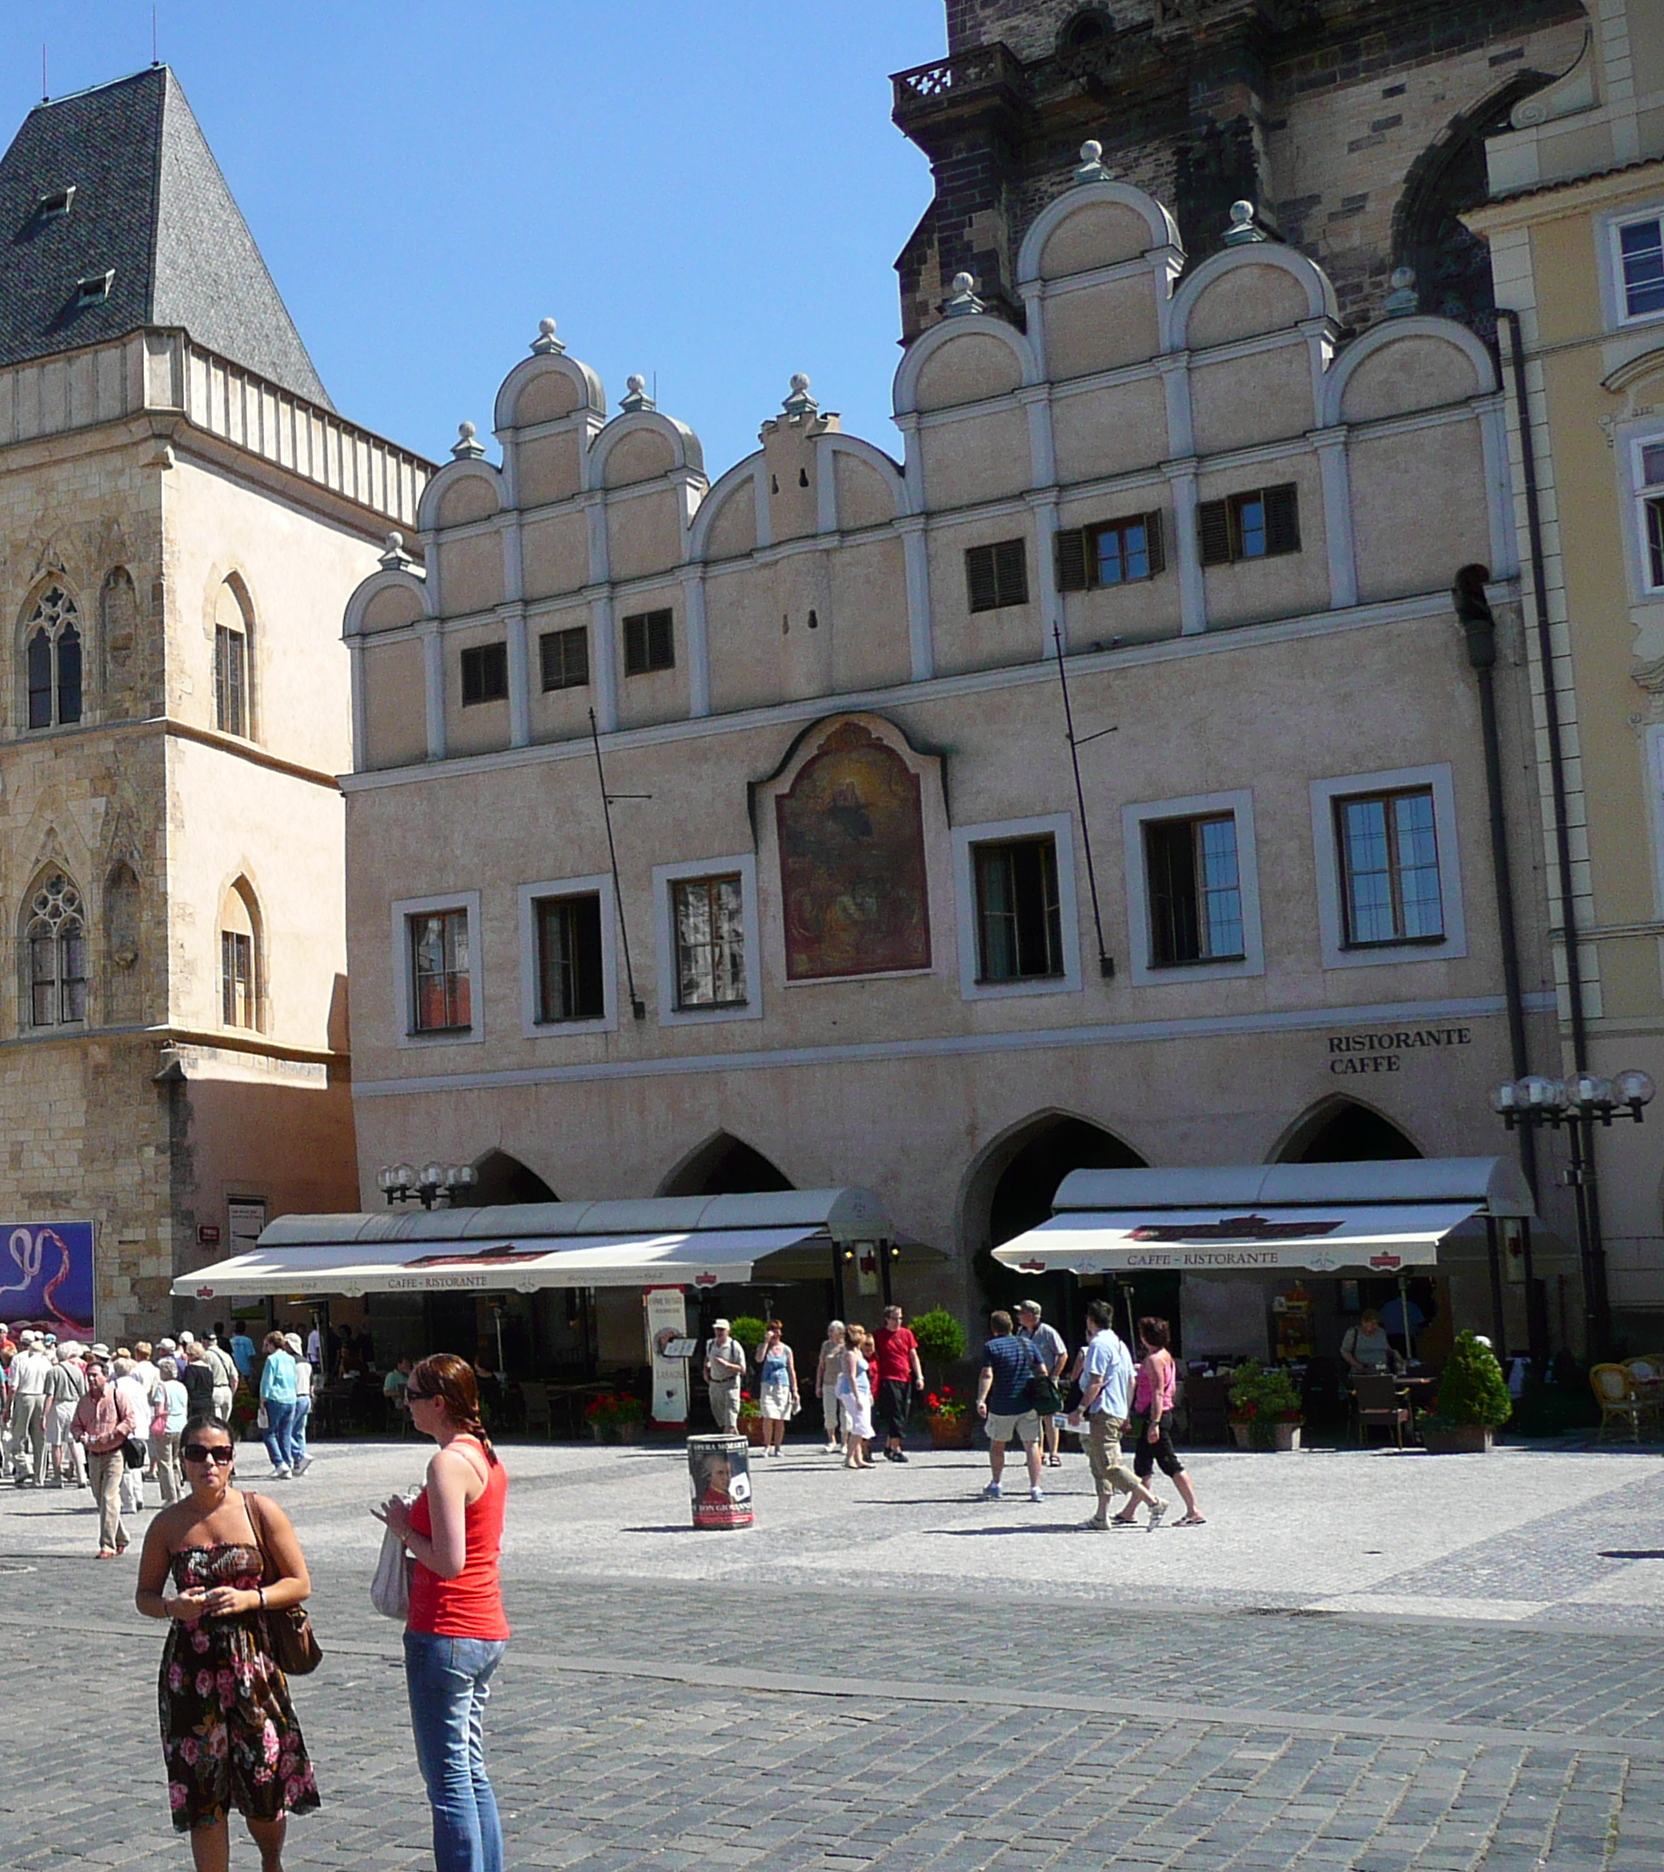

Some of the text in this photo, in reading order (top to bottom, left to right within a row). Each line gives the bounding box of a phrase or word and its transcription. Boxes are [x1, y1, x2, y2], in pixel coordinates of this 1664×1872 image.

[1328, 1028, 1472, 1053] RISTORANTE
[1330, 1055, 1400, 1075] CAFFE
[1127, 1254, 1171, 1265] CAFFE
[1184, 1252, 1278, 1265] RISTORANTE
[388, 1277, 417, 1288] CAFFE
[425, 1276, 487, 1288] RISTORANTE
